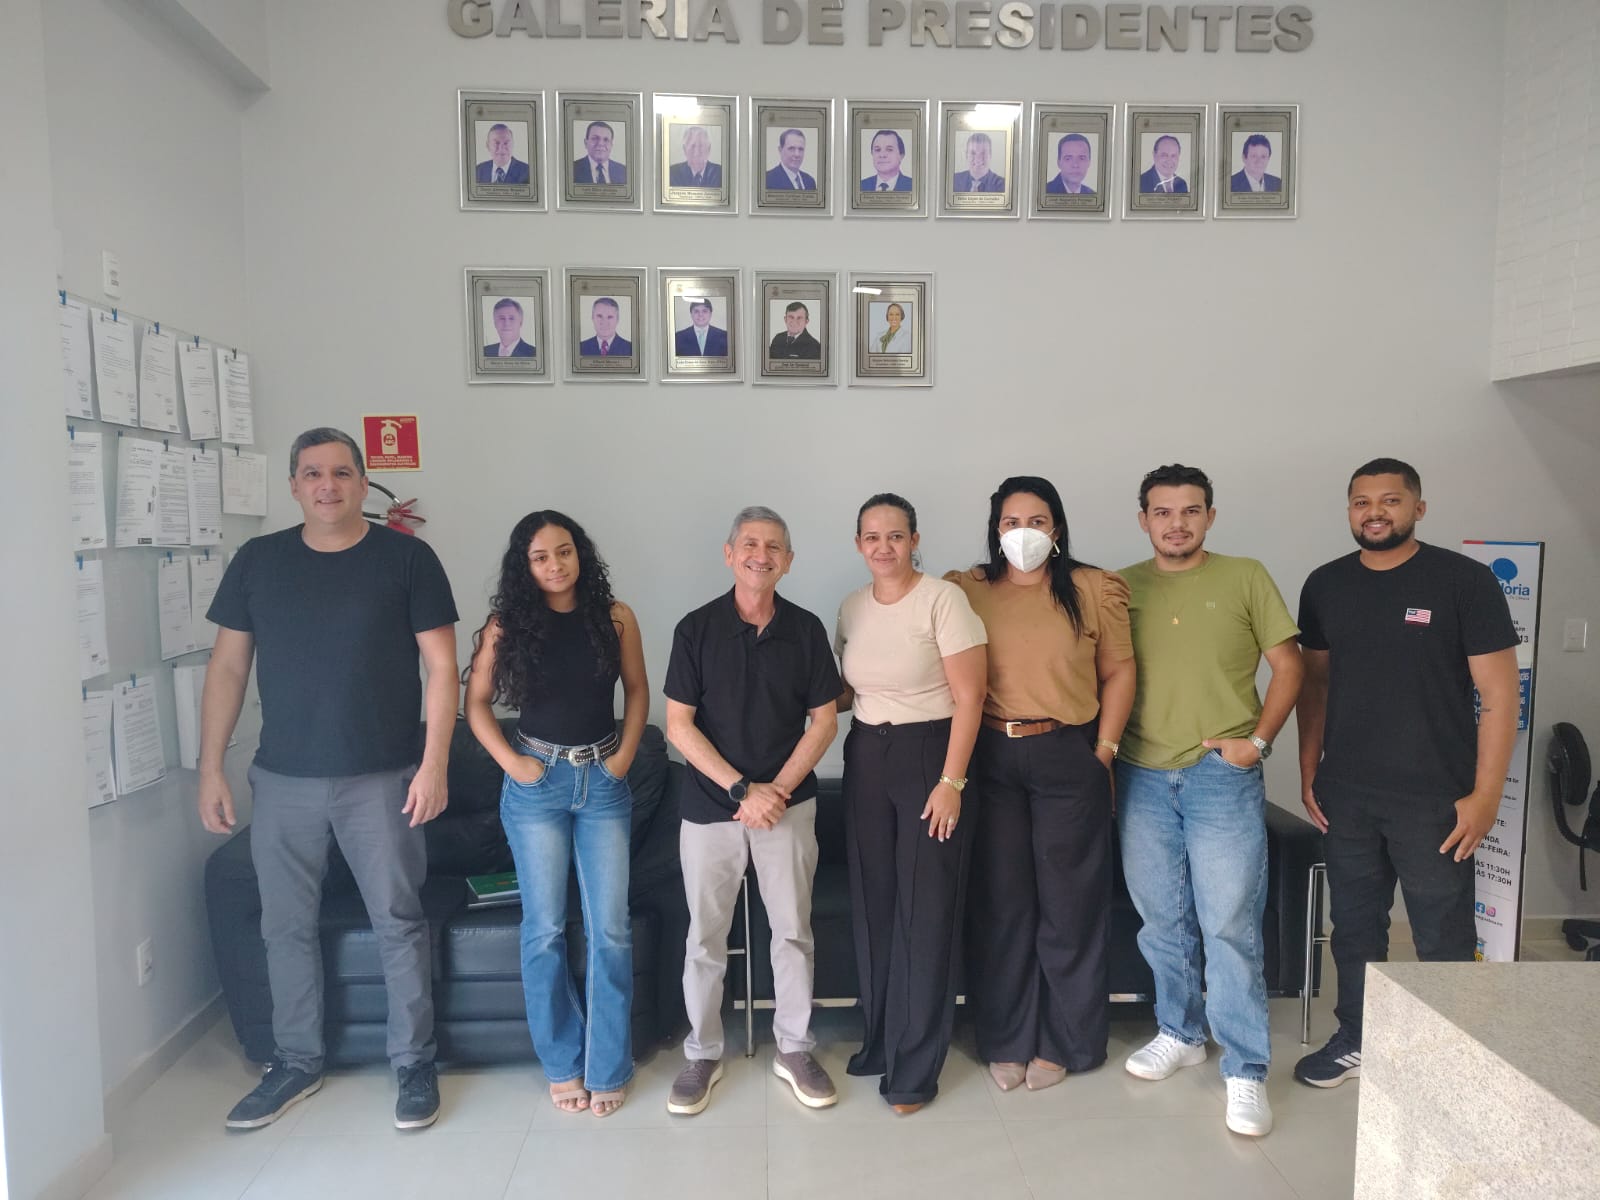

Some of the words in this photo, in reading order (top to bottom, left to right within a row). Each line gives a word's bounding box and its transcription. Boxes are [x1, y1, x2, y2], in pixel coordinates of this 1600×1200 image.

[447, 0, 740, 44] GALERIA
[762, 0, 845, 46] DE
[867, 0, 1315, 52] PRESIDENTES
